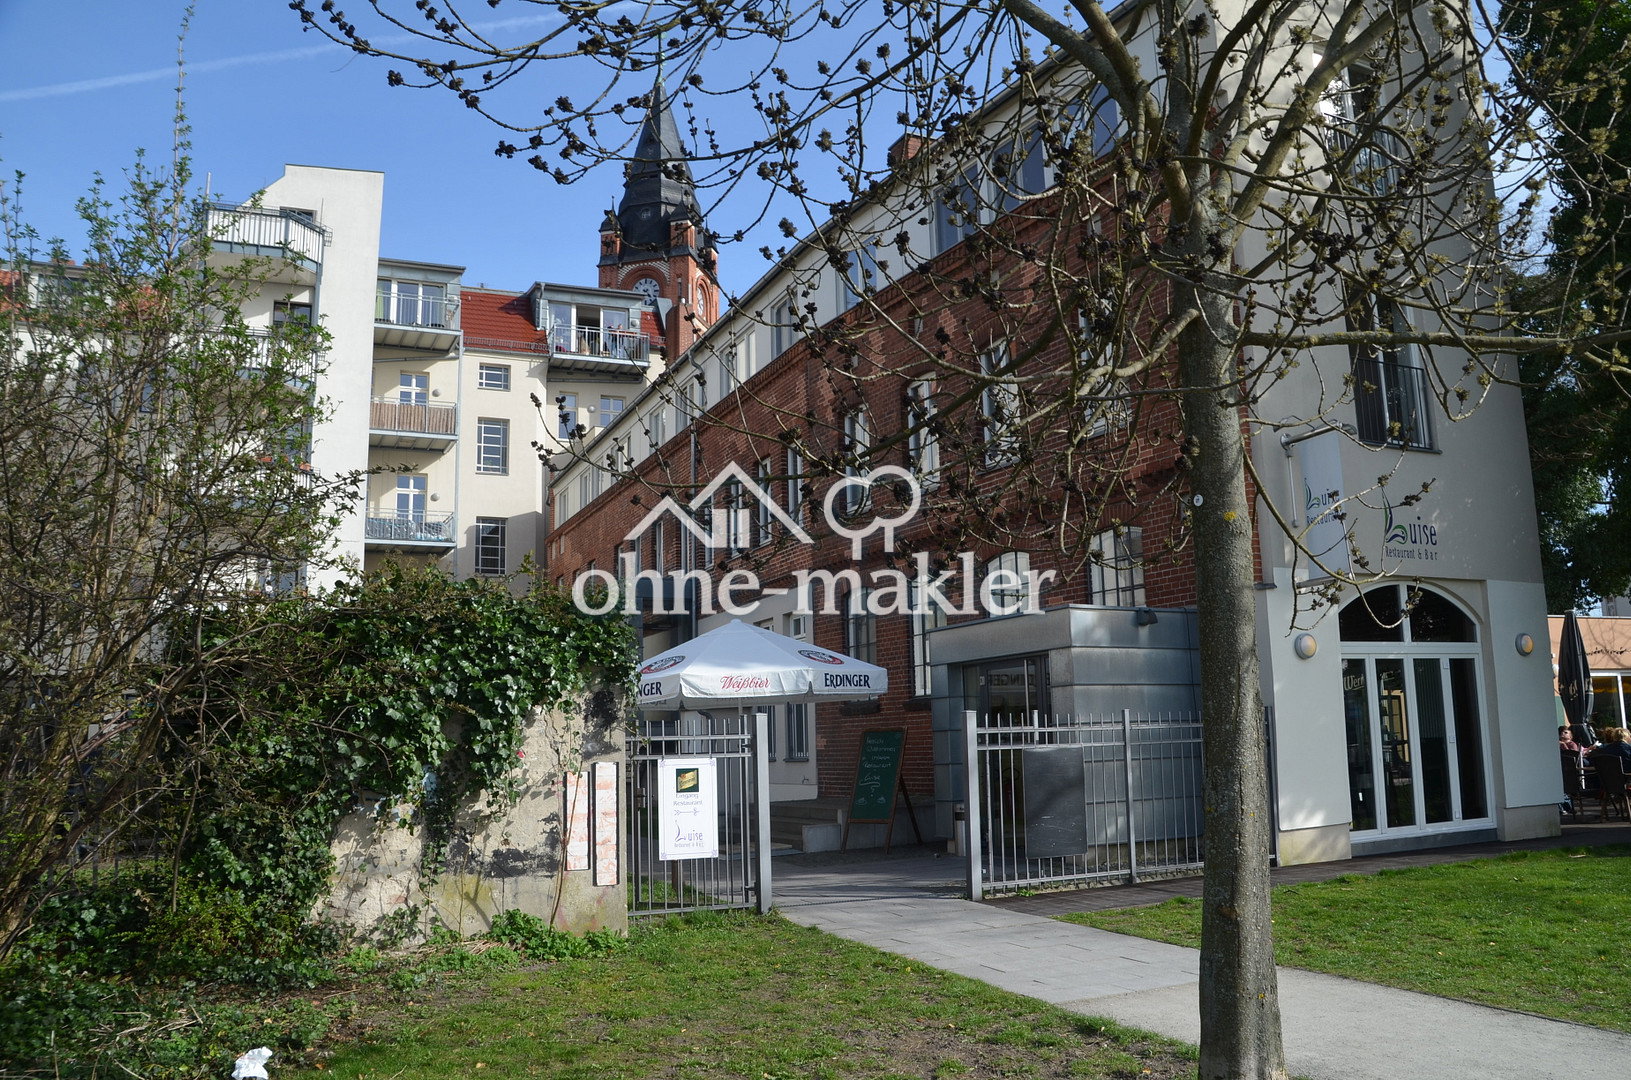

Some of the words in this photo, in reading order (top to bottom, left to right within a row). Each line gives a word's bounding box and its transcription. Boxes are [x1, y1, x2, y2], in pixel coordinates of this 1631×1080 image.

[1380, 486, 1438, 546] Luise
[1384, 546, 1415, 559] Restaurant
[1417, 549, 1423, 559] &
[1424, 549, 1438, 560] Bar
[720, 675, 770, 692] Weißbier
[824, 673, 871, 688] ERDINGER
[674, 819, 704, 843] Luise
